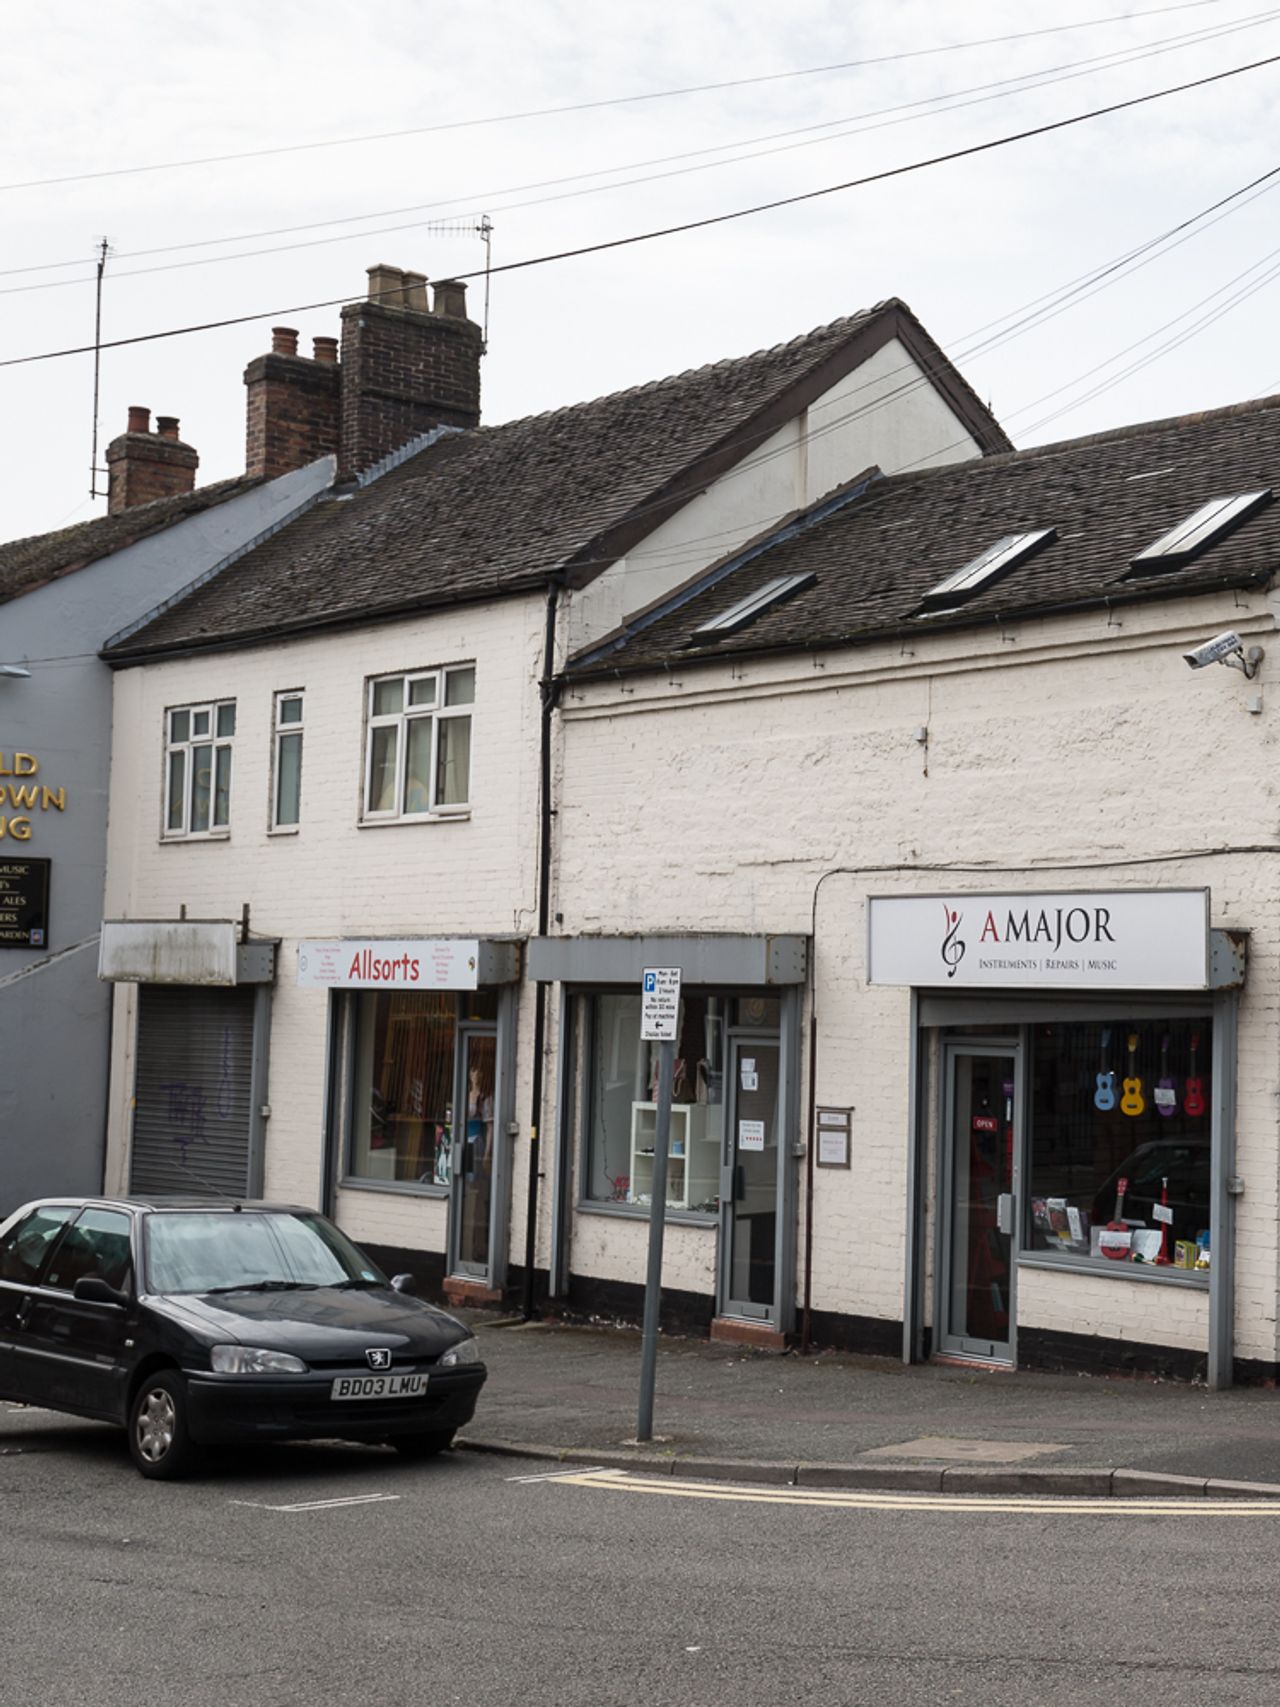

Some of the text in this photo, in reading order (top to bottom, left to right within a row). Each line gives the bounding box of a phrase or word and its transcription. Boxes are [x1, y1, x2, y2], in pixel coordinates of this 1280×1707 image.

[0, 784, 65, 811] WN
[349, 948, 421, 981] Allsorts
[976, 1119, 993, 1128] OPEN
[338, 1376, 422, 1396] BD03 LMU
